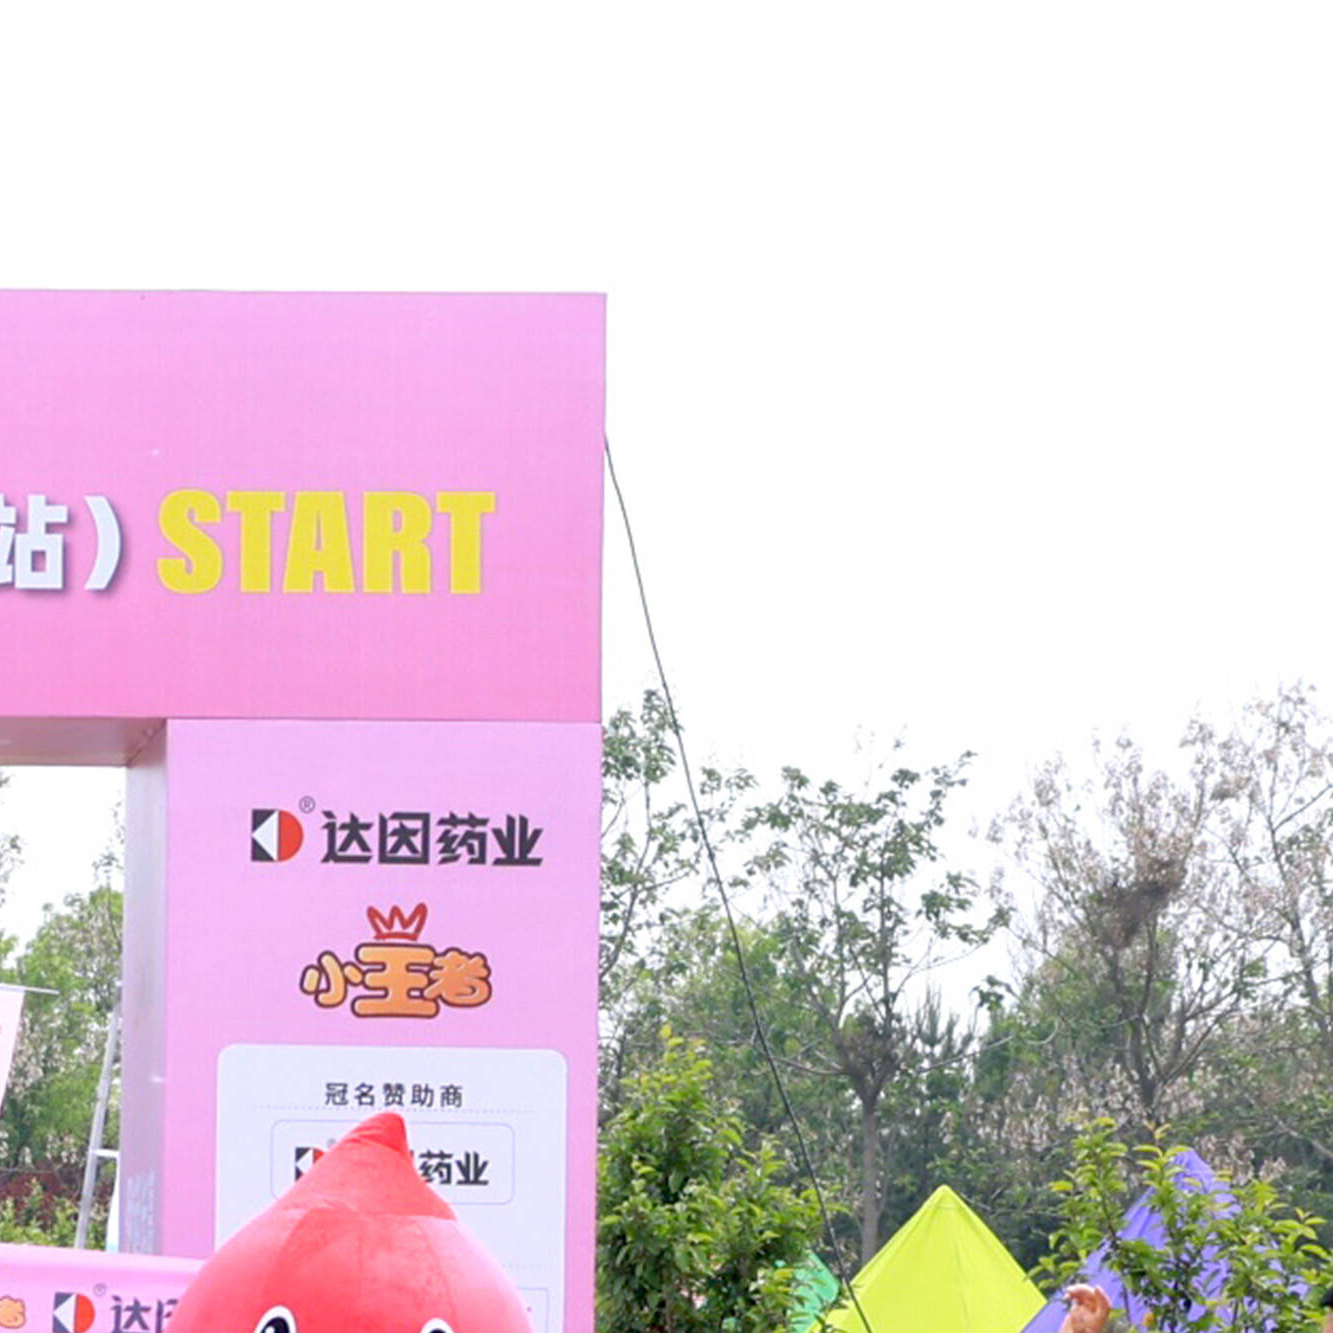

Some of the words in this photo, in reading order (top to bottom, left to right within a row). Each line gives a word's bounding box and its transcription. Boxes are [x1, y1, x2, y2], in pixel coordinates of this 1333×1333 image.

[156, 488, 495, 596] START
[321, 811, 544, 866] 达因药业
[300, 943, 492, 1019] 小王者
[324, 1082, 464, 1108] 冠名赞助商
[410, 1149, 489, 1186] 药业
